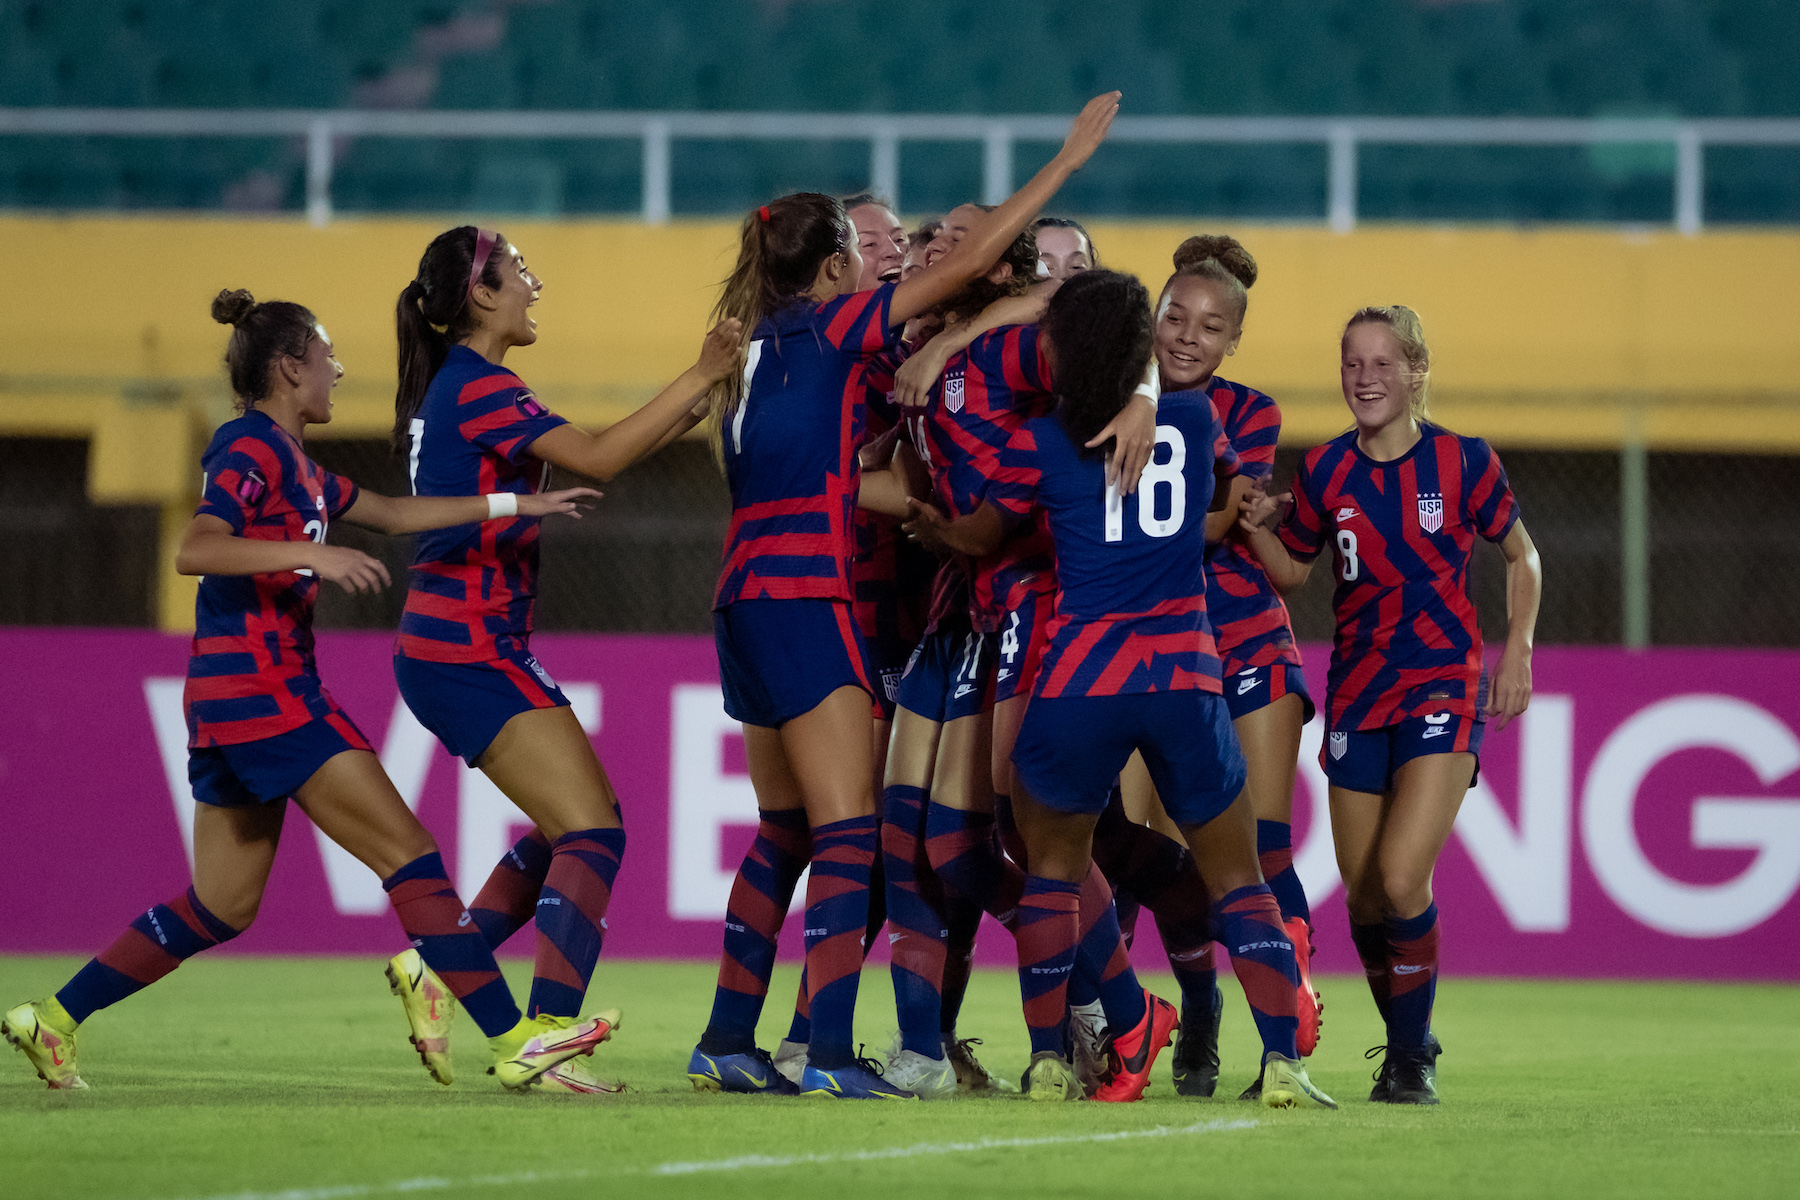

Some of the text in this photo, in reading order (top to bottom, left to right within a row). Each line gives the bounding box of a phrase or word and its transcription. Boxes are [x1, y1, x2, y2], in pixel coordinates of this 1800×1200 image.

[946, 381, 963, 394] USA
[1420, 501, 1441, 514] USA
[1337, 529, 1359, 581] 8
[956, 632, 985, 683] 11
[1238, 941, 1292, 953] STATES
